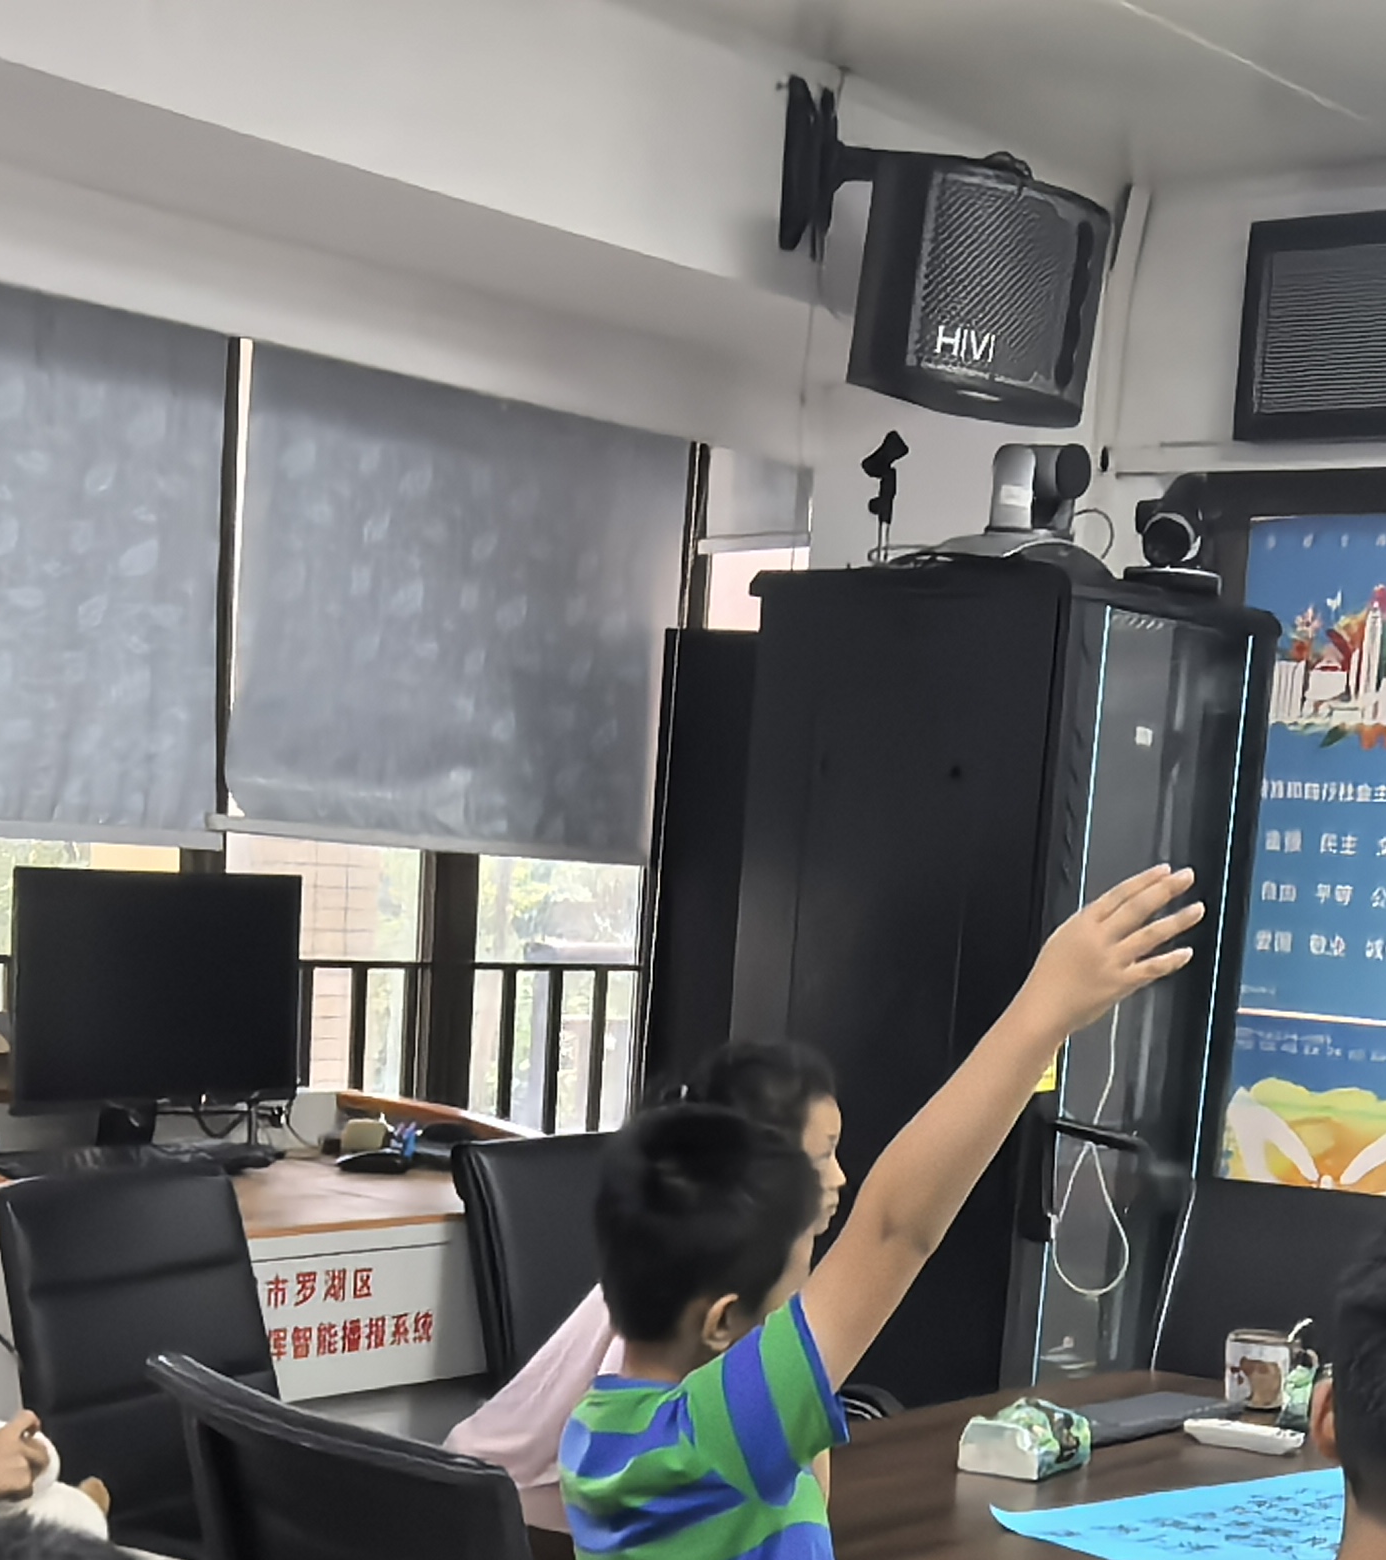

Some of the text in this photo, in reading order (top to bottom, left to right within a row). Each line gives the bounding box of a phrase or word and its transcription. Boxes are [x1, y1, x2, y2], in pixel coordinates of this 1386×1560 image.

[1320, 832, 1358, 855] 民主
[1262, 880, 1297, 903] 自由
[1316, 884, 1354, 906] 平等
[1310, 934, 1347, 957] 敬业
[265, 1267, 373, 1310] 市罗湖区
